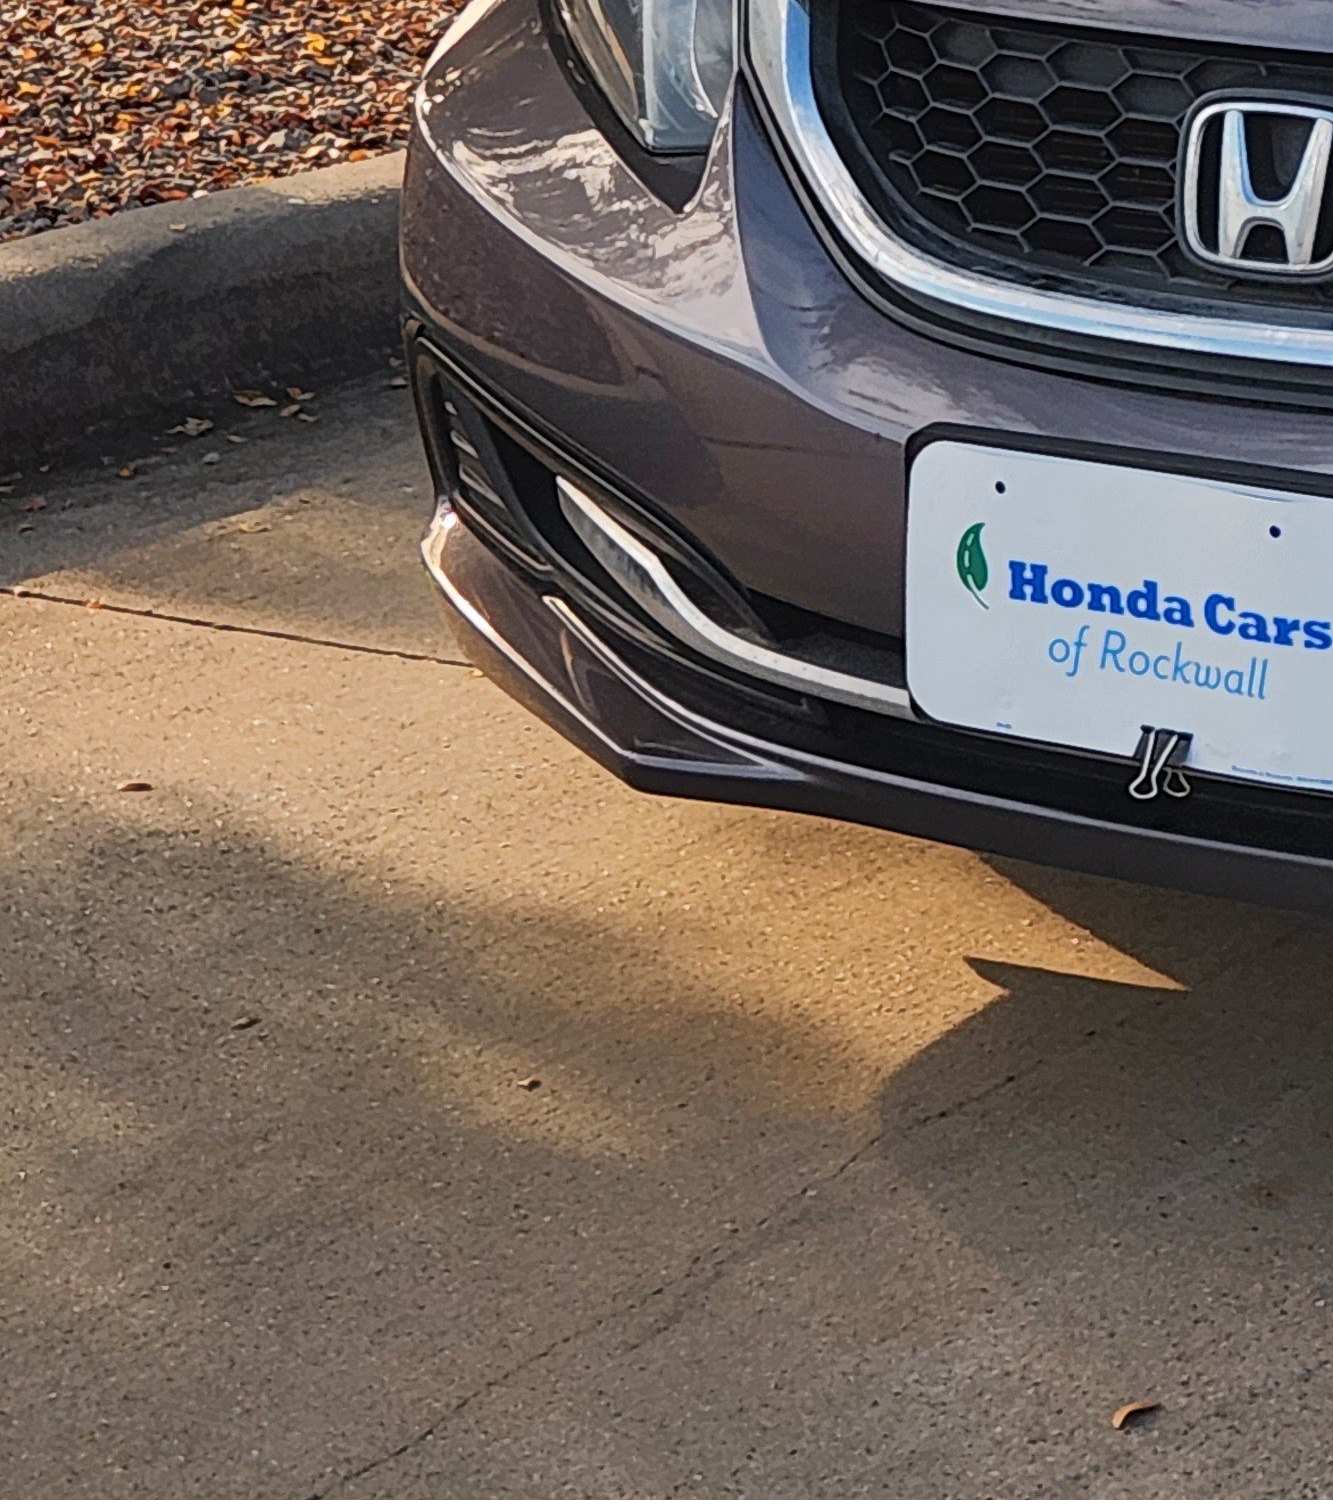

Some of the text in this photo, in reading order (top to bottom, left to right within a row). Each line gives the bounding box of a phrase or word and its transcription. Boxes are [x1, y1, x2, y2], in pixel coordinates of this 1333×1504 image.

[1008, 559, 1333, 651] Honda Cars
[1047, 625, 1269, 700] of Rockwall
